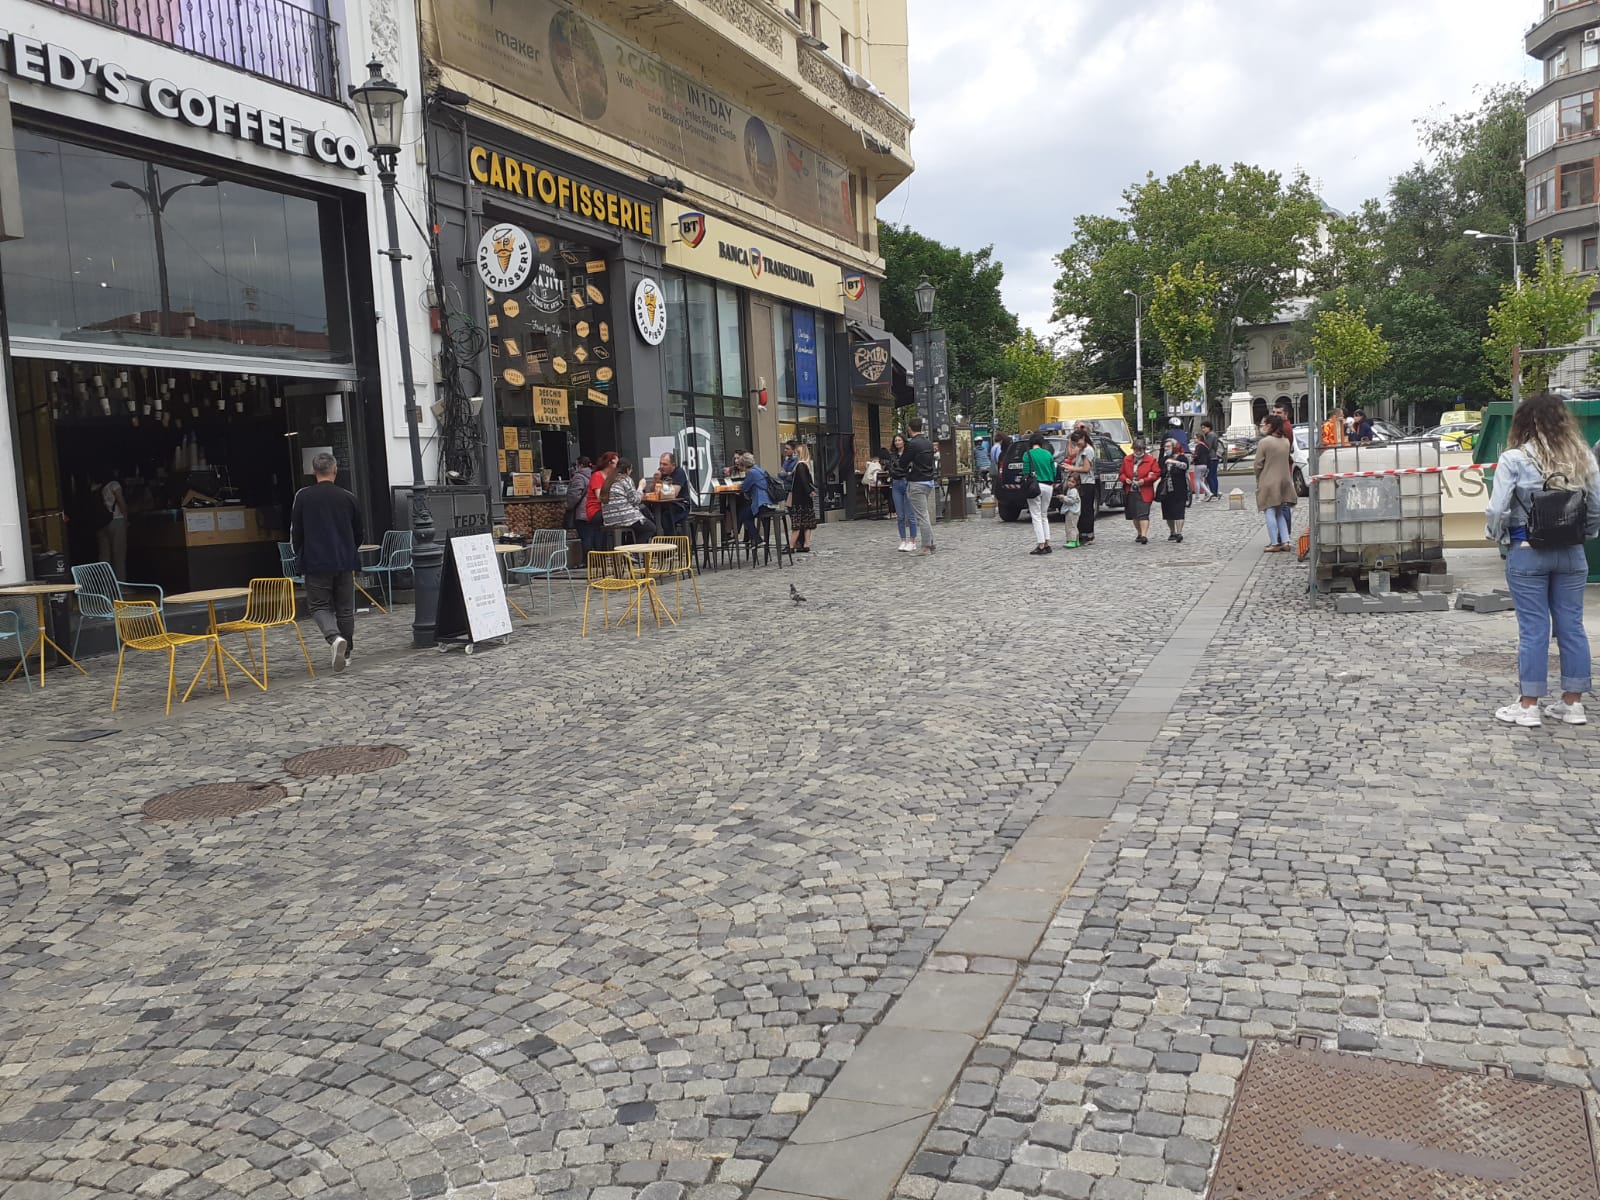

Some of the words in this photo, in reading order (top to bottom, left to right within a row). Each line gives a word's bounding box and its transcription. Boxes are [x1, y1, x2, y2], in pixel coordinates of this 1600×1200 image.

[494, 28, 541, 62] maker
[687, 84, 702, 107] IN
[709, 98, 733, 124] DAY
[145, 77, 304, 154] COFFEE
[312, 129, 371, 176] CO.
[470, 145, 653, 236] CARTOFISSERIE
[682, 219, 699, 234] BT
[479, 241, 529, 288] CARTOFISSERIE
[718, 240, 750, 268] BANCA
[762, 255, 815, 288] TRANSILVANIA
[847, 279, 860, 290] BT
[687, 446, 706, 470] BT
[454, 513, 486, 529] TED'S
